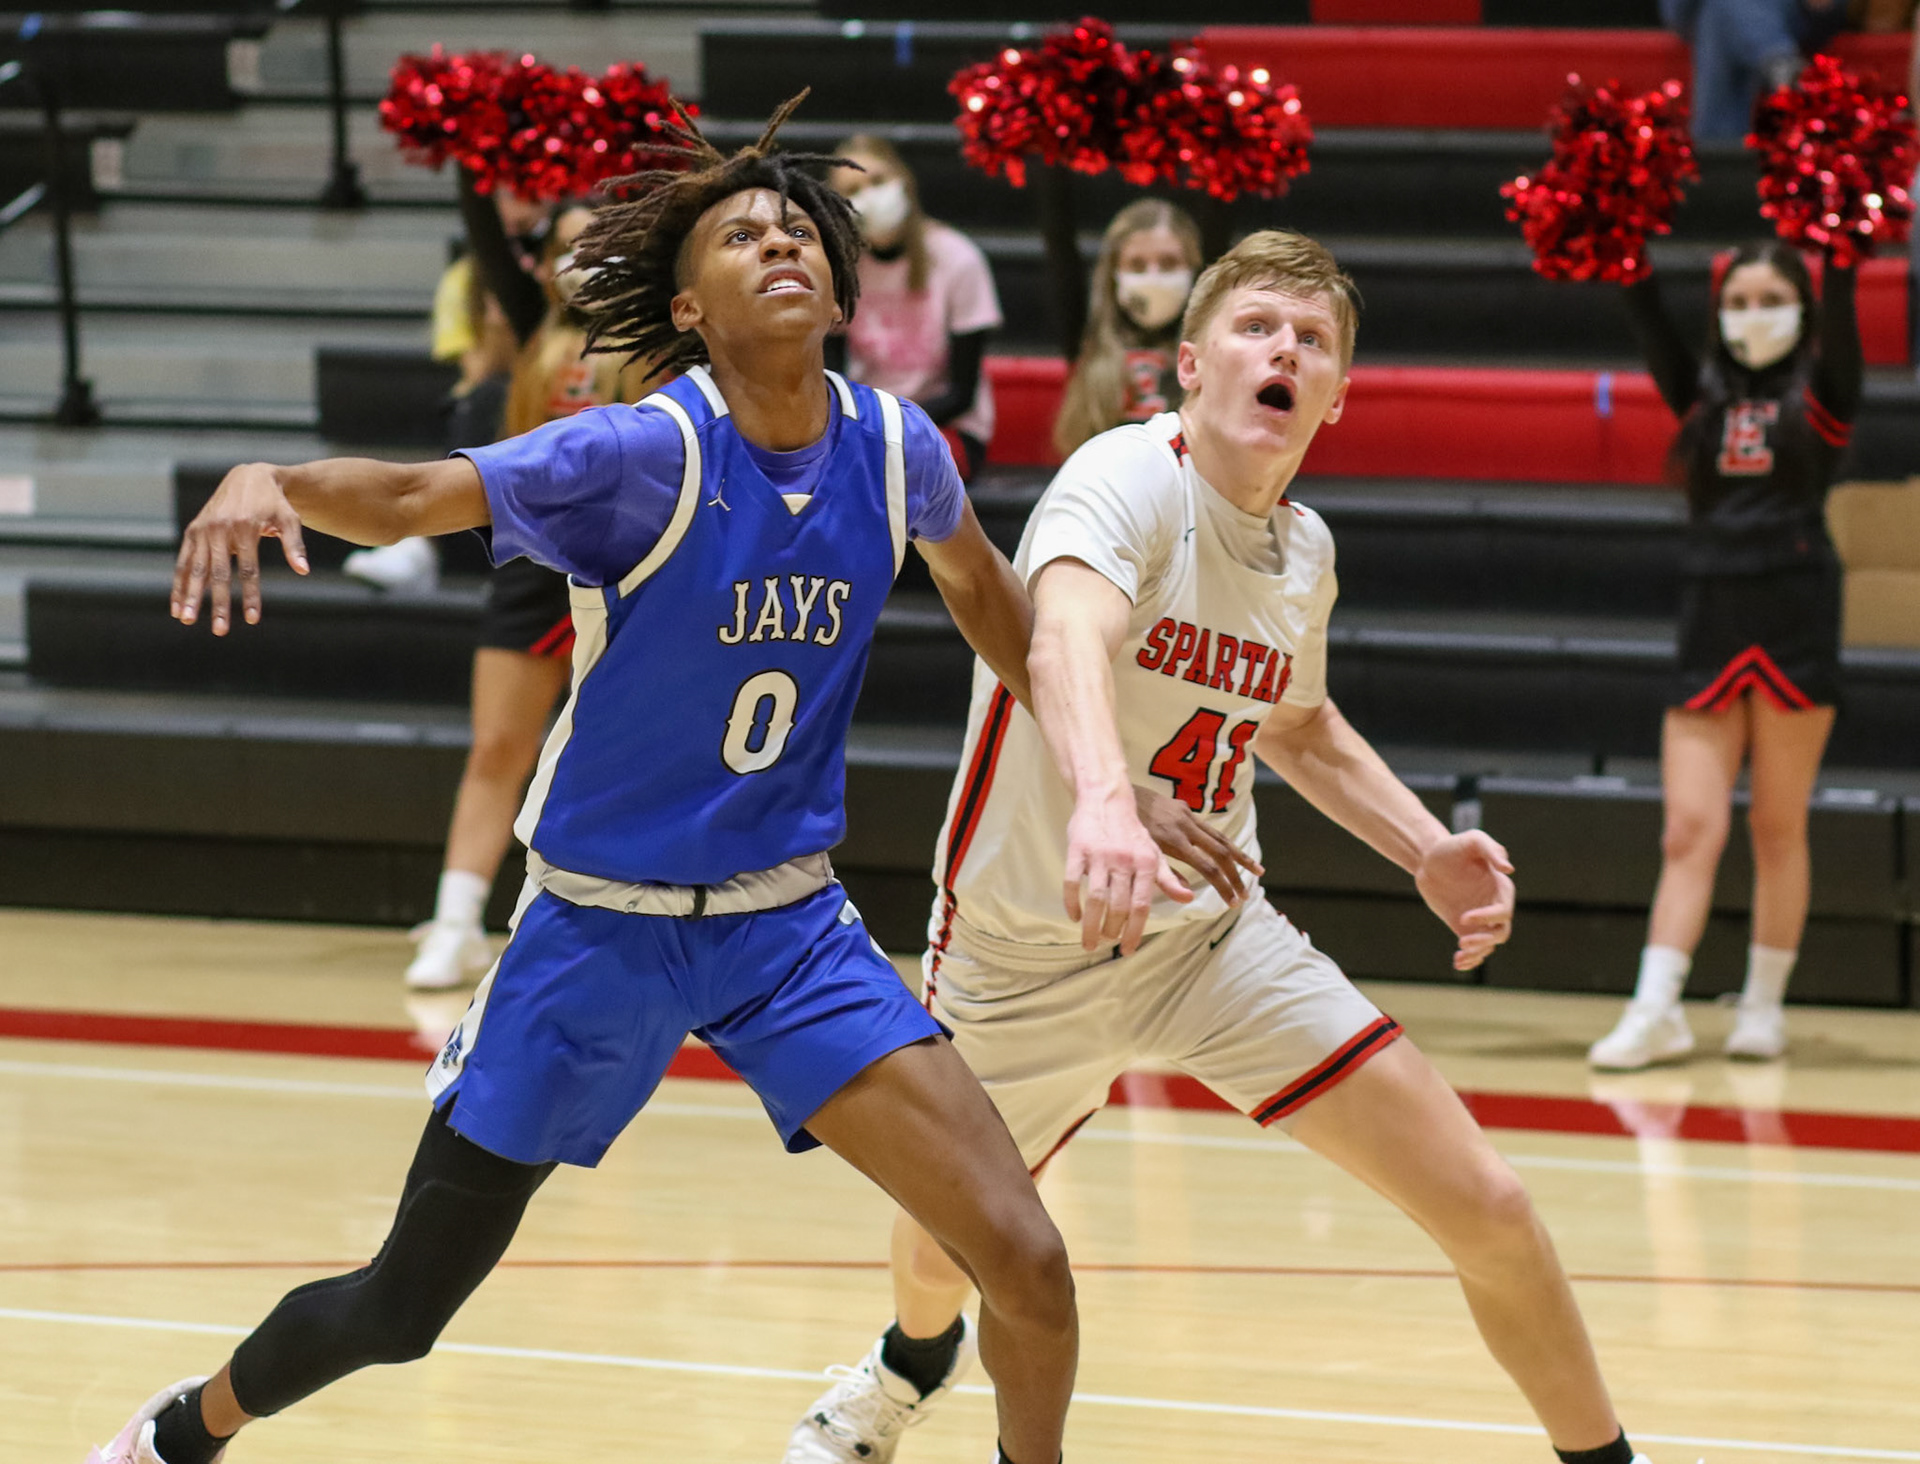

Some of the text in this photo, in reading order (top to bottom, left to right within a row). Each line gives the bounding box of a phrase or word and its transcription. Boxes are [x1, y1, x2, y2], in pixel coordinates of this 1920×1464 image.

[1717, 401, 1779, 475] E
[718, 573, 852, 647] JAYS
[720, 667, 800, 776] 0
[1147, 706, 1260, 814] 41
